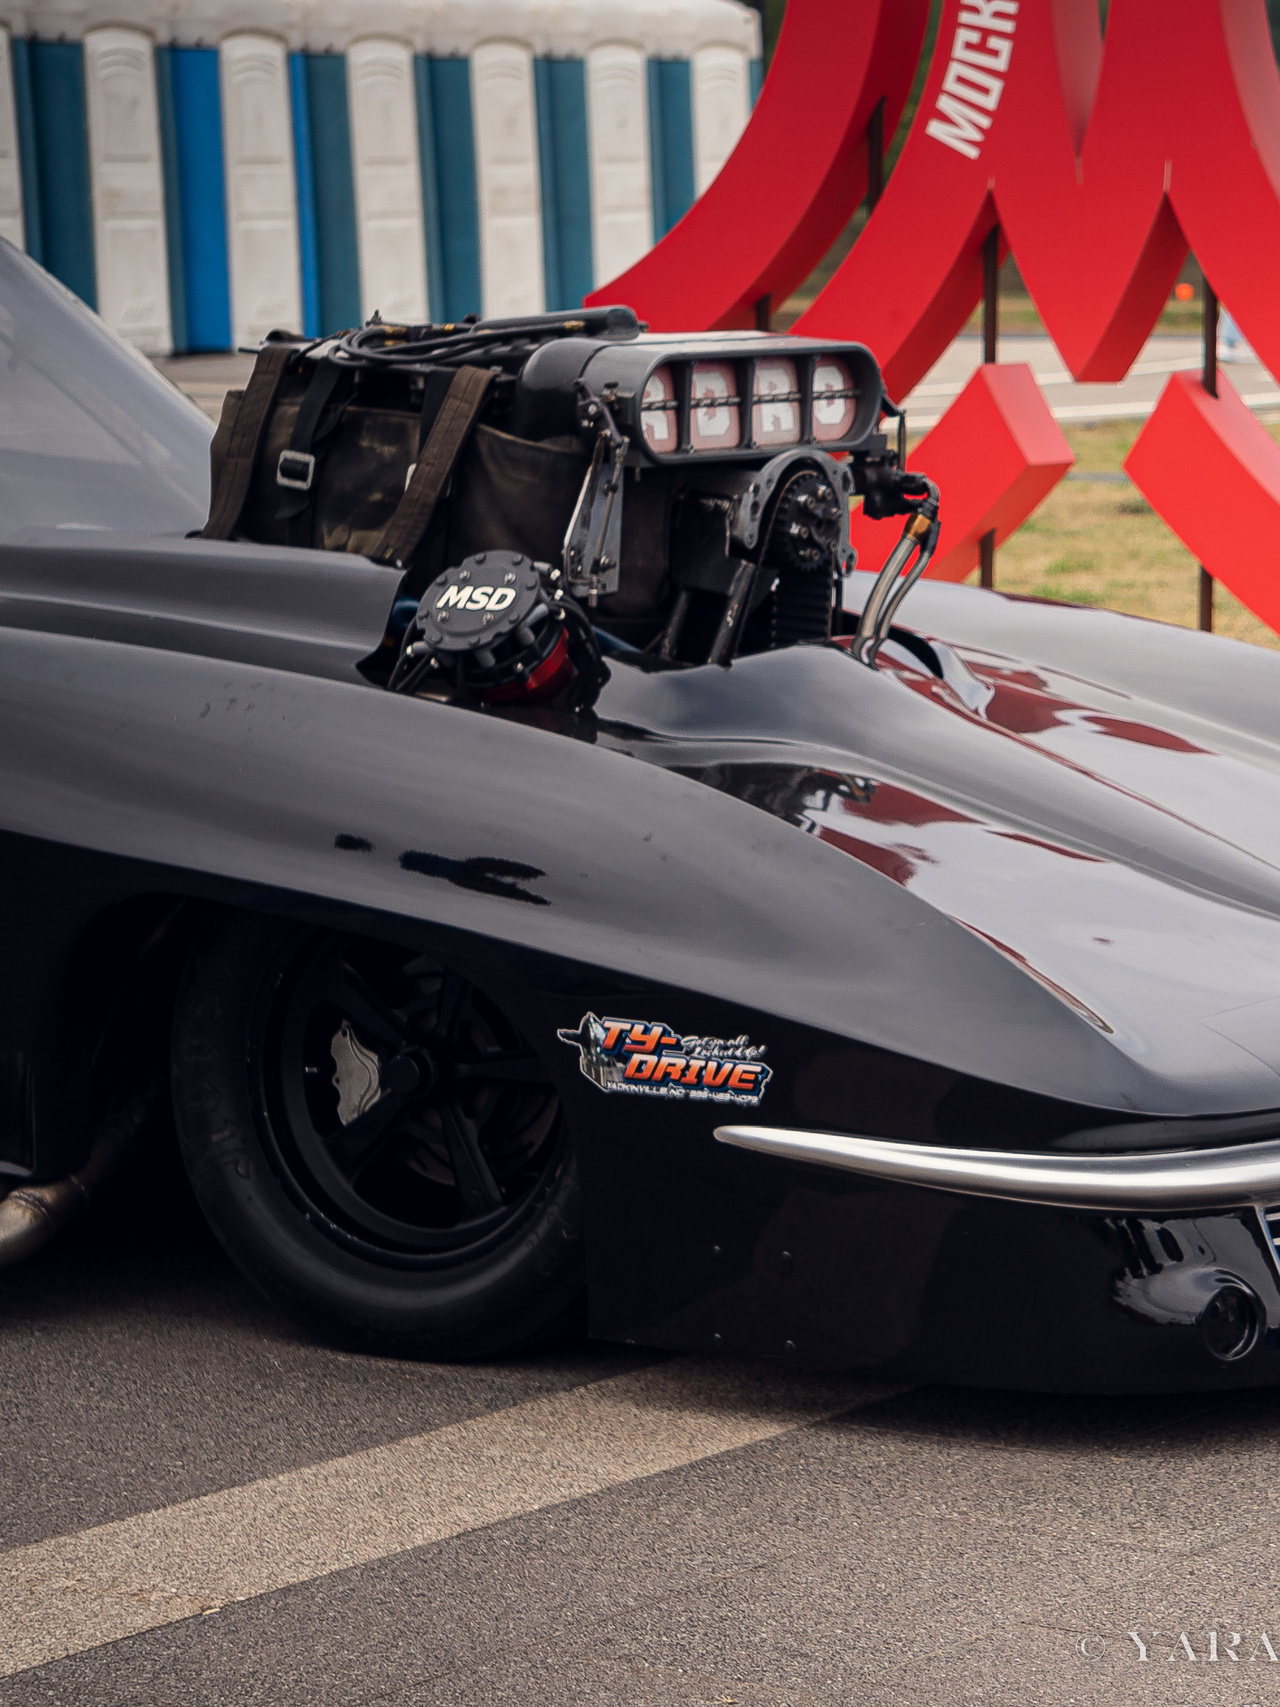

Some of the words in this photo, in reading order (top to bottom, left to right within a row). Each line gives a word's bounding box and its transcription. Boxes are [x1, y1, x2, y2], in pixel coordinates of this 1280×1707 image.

[925, 0, 1020, 161] МОСК
[435, 585, 517, 611] MSD
[602, 1020, 678, 1053] TY-
[623, 1053, 763, 1091] DRIVE
